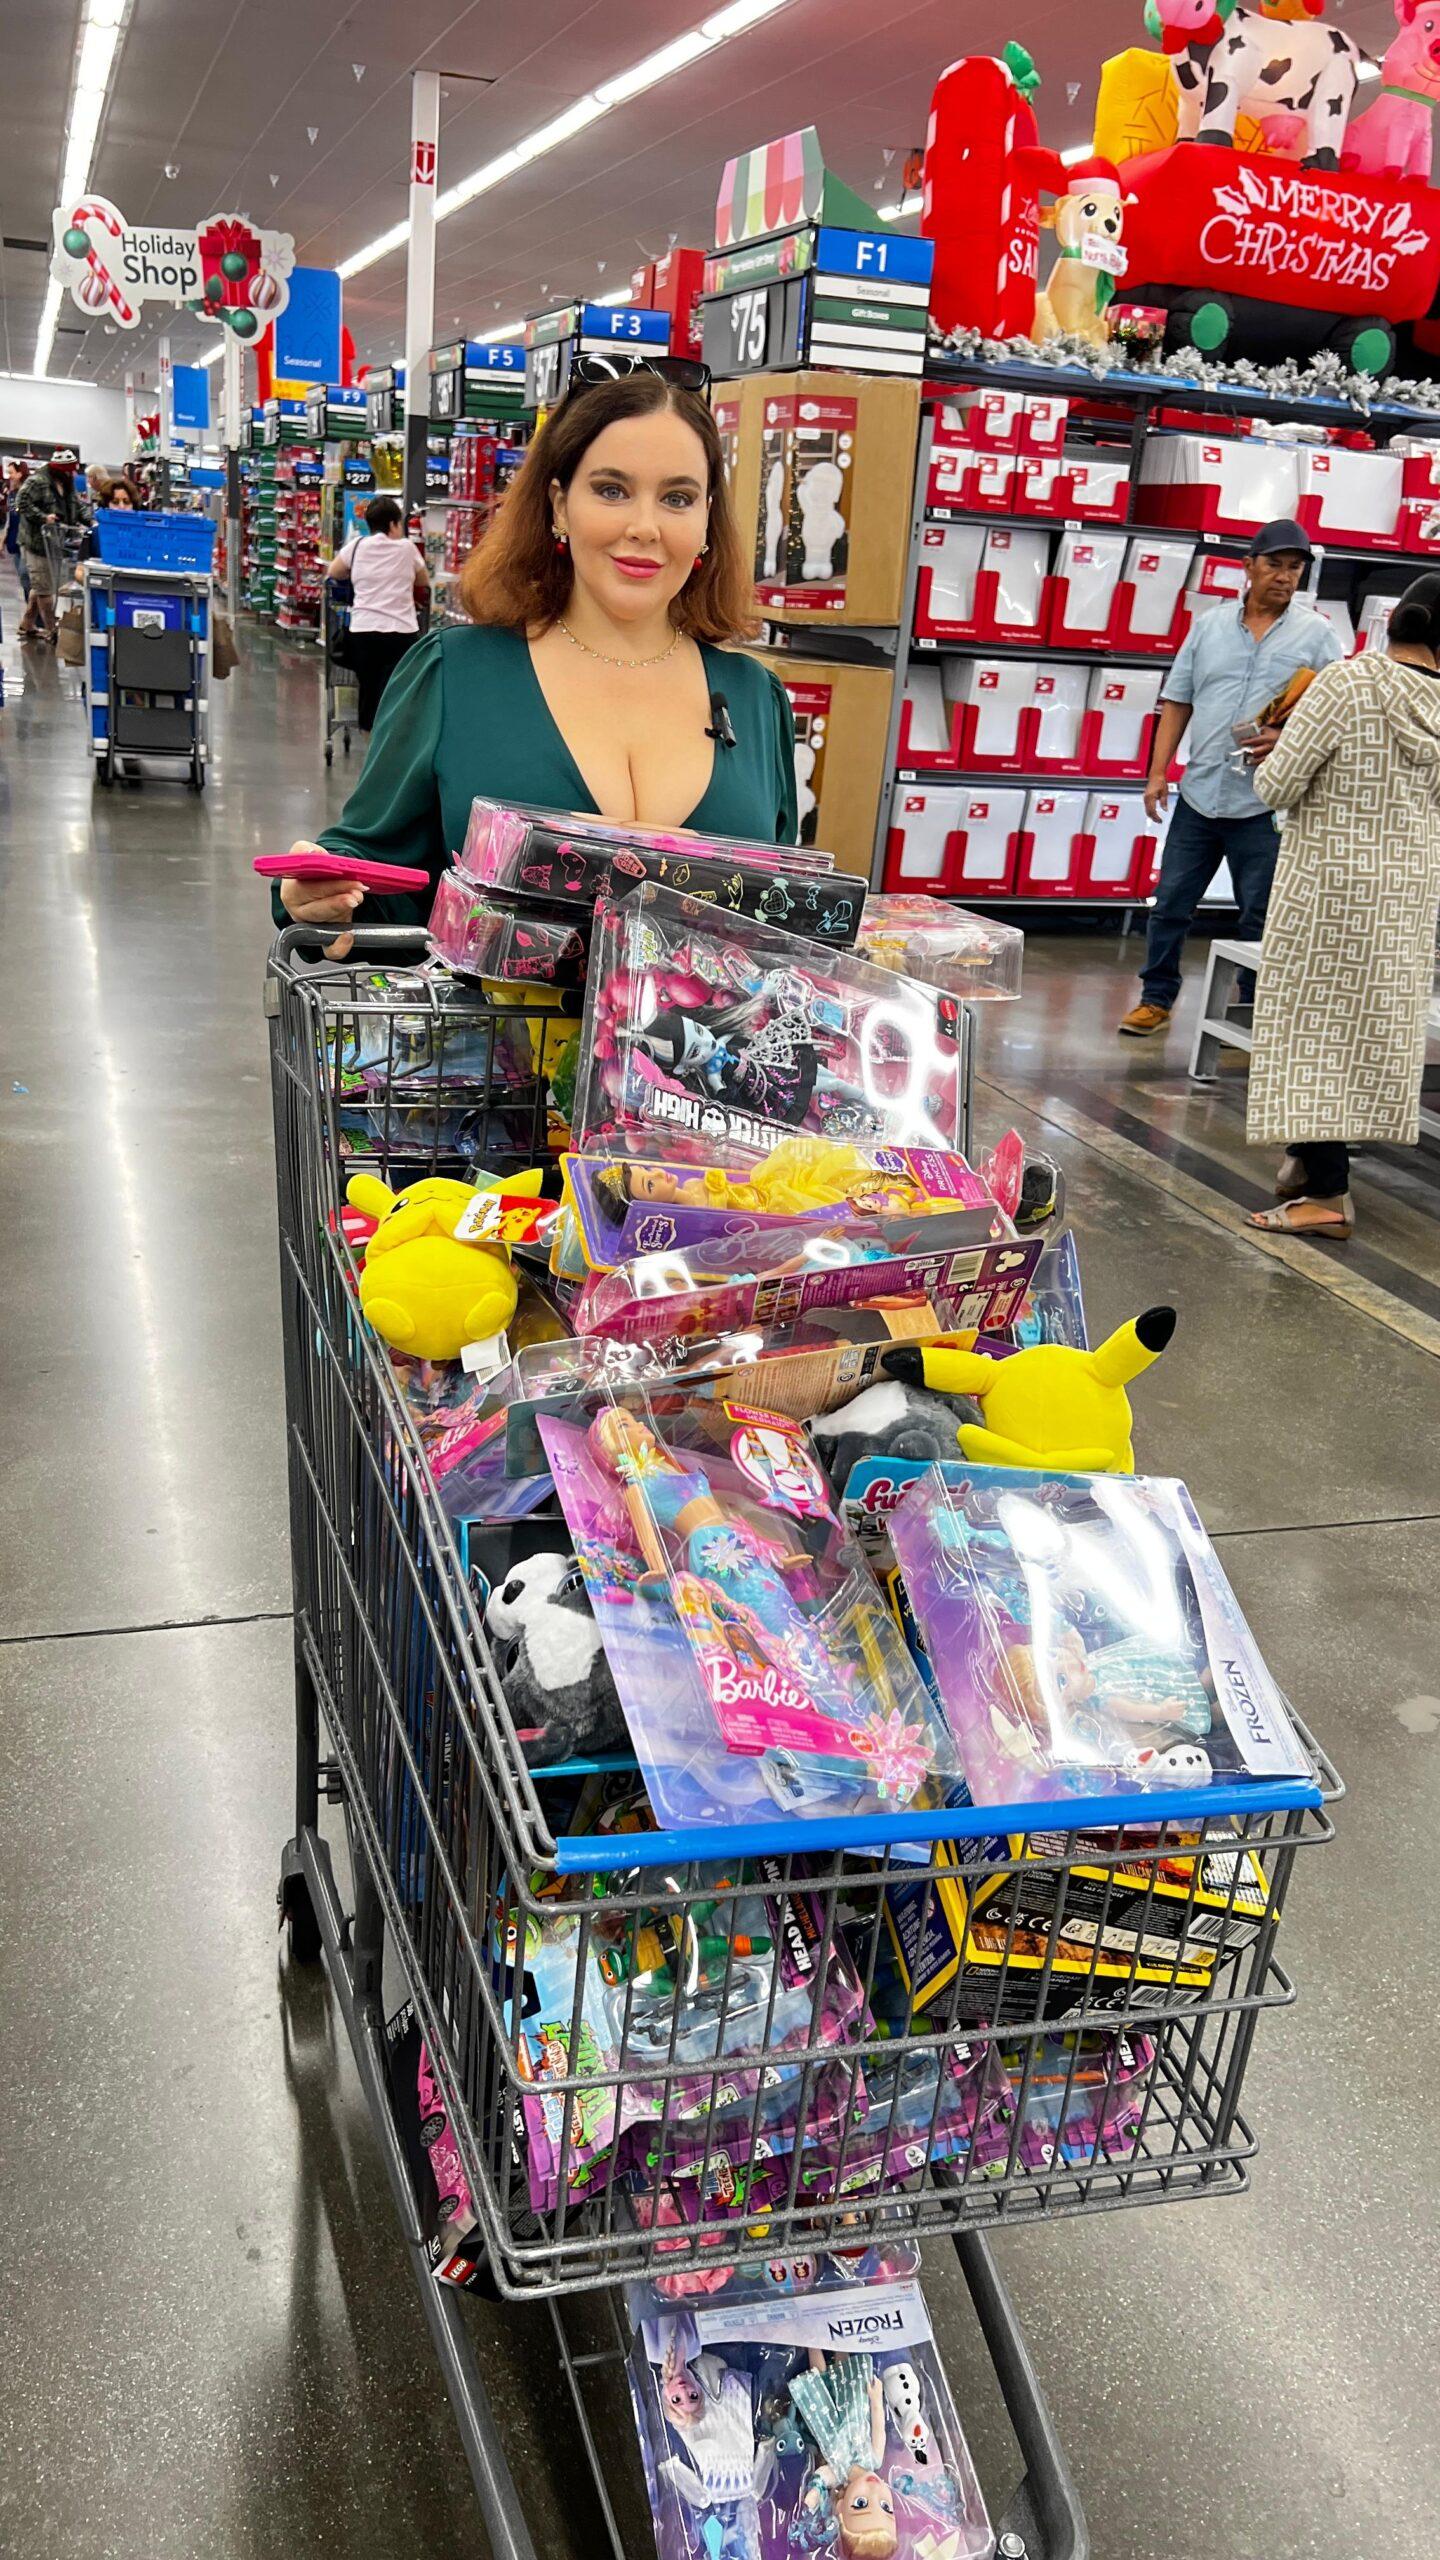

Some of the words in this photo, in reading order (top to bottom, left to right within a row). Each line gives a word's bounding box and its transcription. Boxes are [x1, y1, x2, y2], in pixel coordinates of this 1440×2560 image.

[1268, 176, 1384, 234] MERRY
[121, 233, 195, 261] Holiday
[856, 241, 887, 272] F1
[123, 255, 197, 294] Shop
[283, 354, 322, 368] Seasonal
[651, 1088, 700, 1131] HIGH
[924, 1153, 949, 1192] PRINCESS
[733, 1405, 769, 1419] FLOWER
[704, 1655, 810, 1710] Barbie
[1220, 1659, 1273, 1745] FROZEN
[787, 1925, 812, 1972] HEAD
[450, 2259, 468, 2279] LEGO
[827, 2309, 905, 2342] FROZEN
